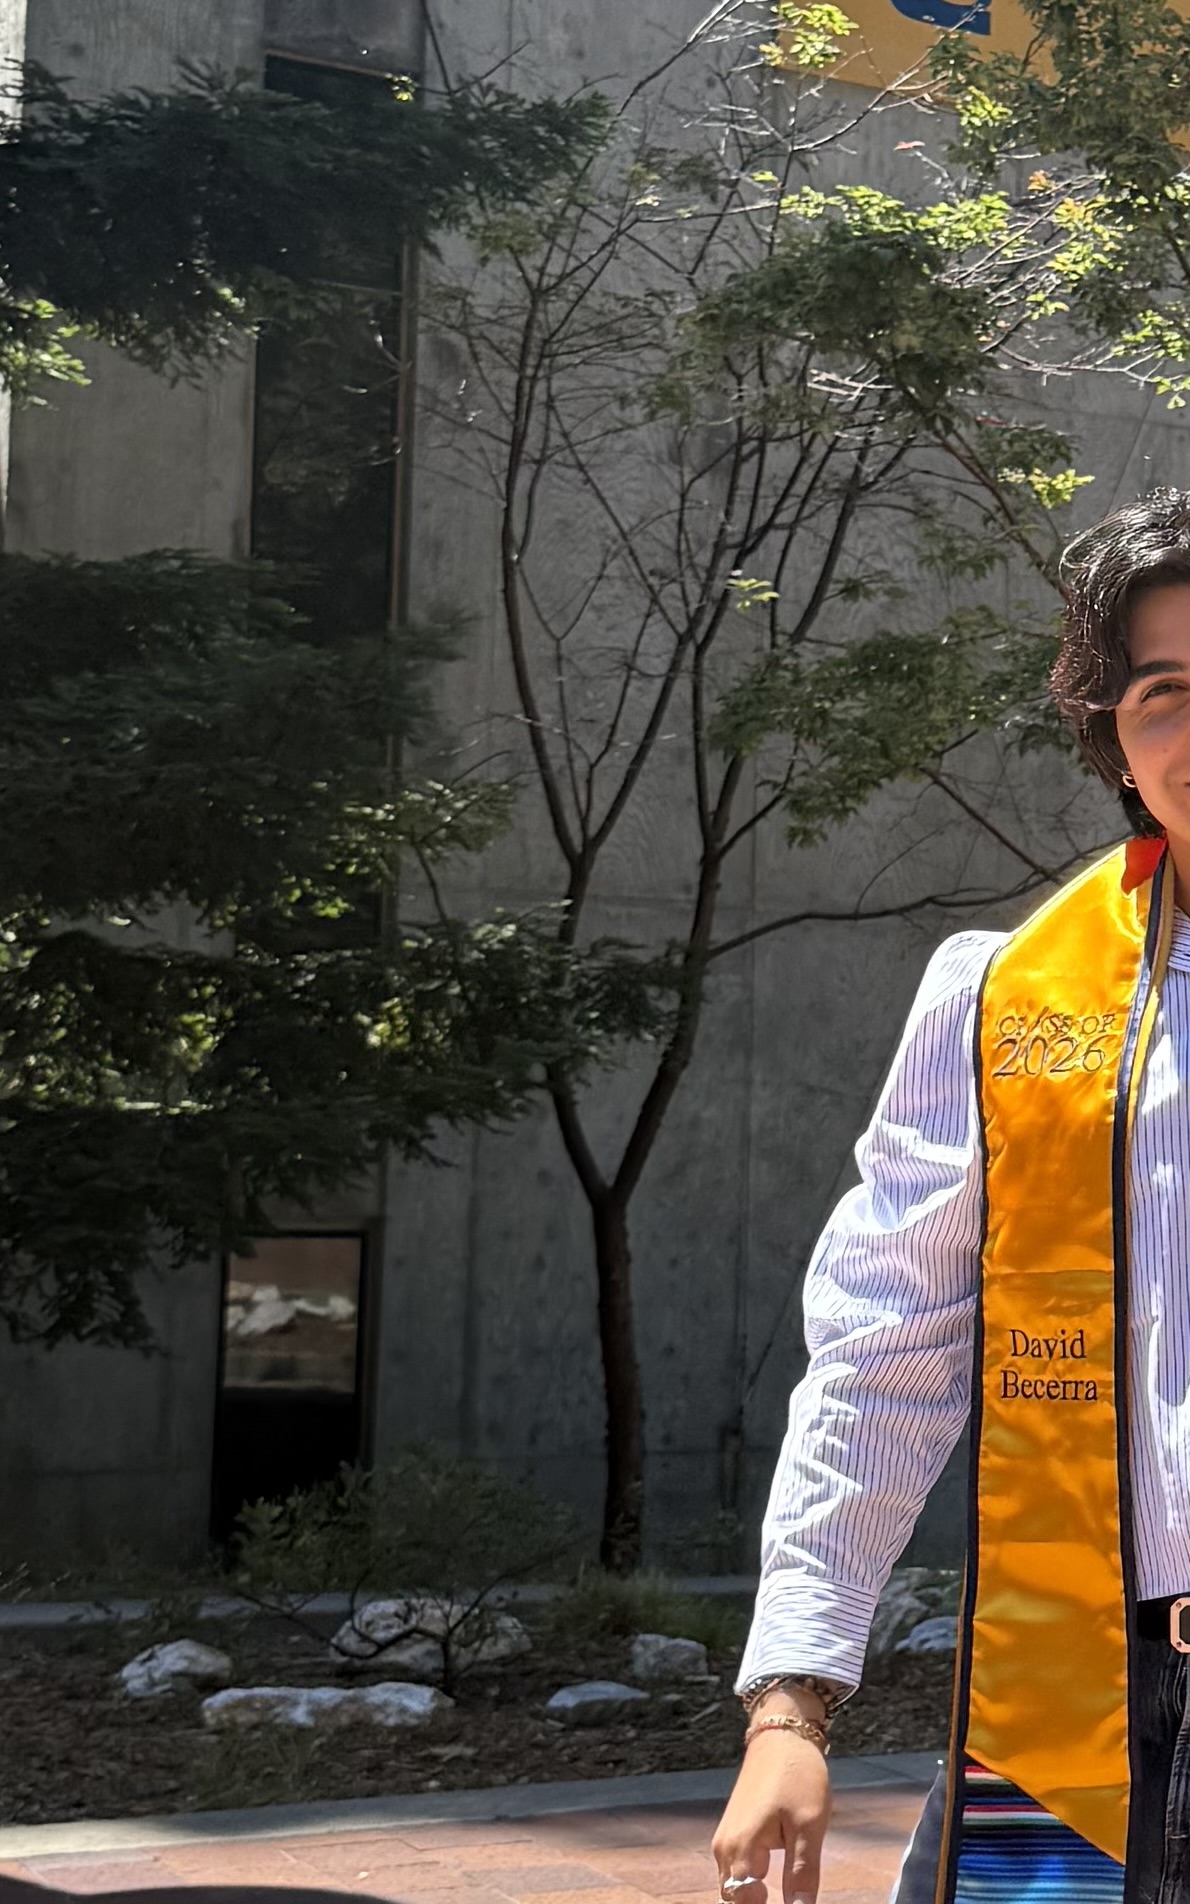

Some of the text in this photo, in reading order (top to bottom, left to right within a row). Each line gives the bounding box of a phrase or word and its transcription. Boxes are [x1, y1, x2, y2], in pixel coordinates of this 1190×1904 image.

[1080, 1013, 1116, 1036] OF
[991, 1034, 1119, 1077] 2026
[1009, 1328, 1087, 1360] David
[1000, 1369, 1098, 1401] Becerra
